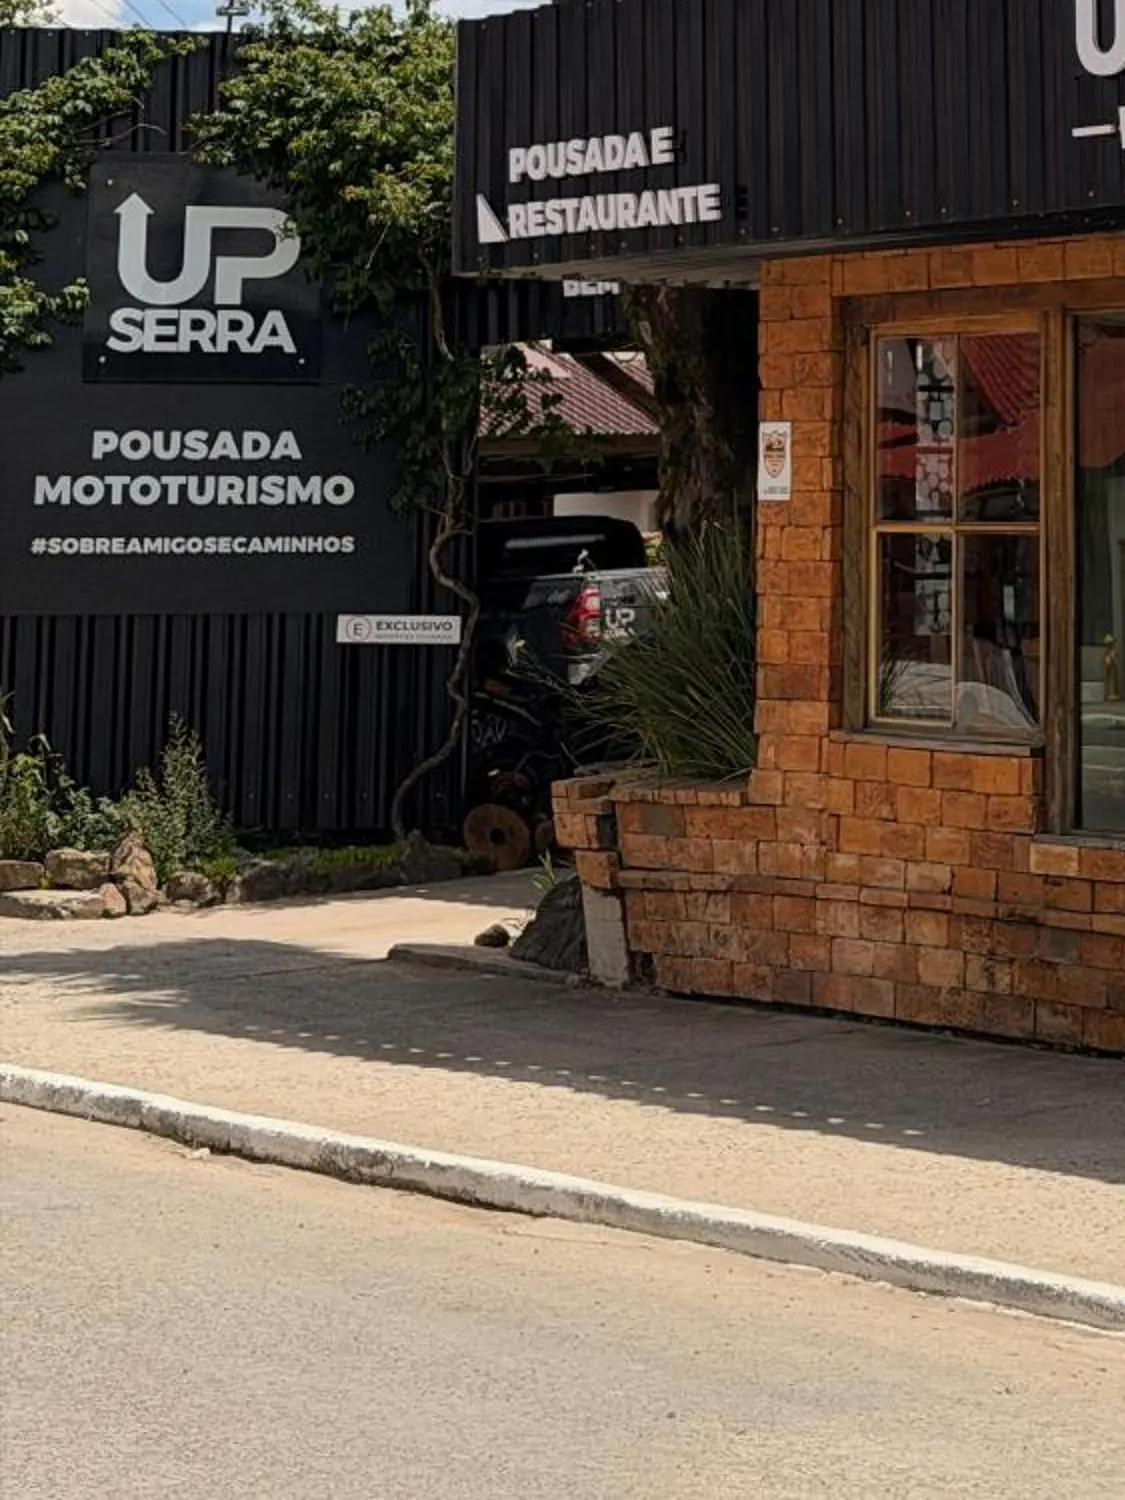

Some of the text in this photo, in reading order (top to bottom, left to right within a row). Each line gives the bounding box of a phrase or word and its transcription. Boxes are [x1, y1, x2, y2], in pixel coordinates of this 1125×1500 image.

[509, 126, 674, 183] POUSADA E
[508, 183, 721, 239] RESTAURANTE
[114, 192, 302, 305] UP
[106, 307, 297, 353] SERRA
[92, 429, 302, 461] POUSADA
[34, 475, 355, 506] MOTOTURISMO
[30, 536, 355, 555] #SOBREAMIGOSECAMINHOS
[375, 620, 453, 632] EXCLUSIVO
